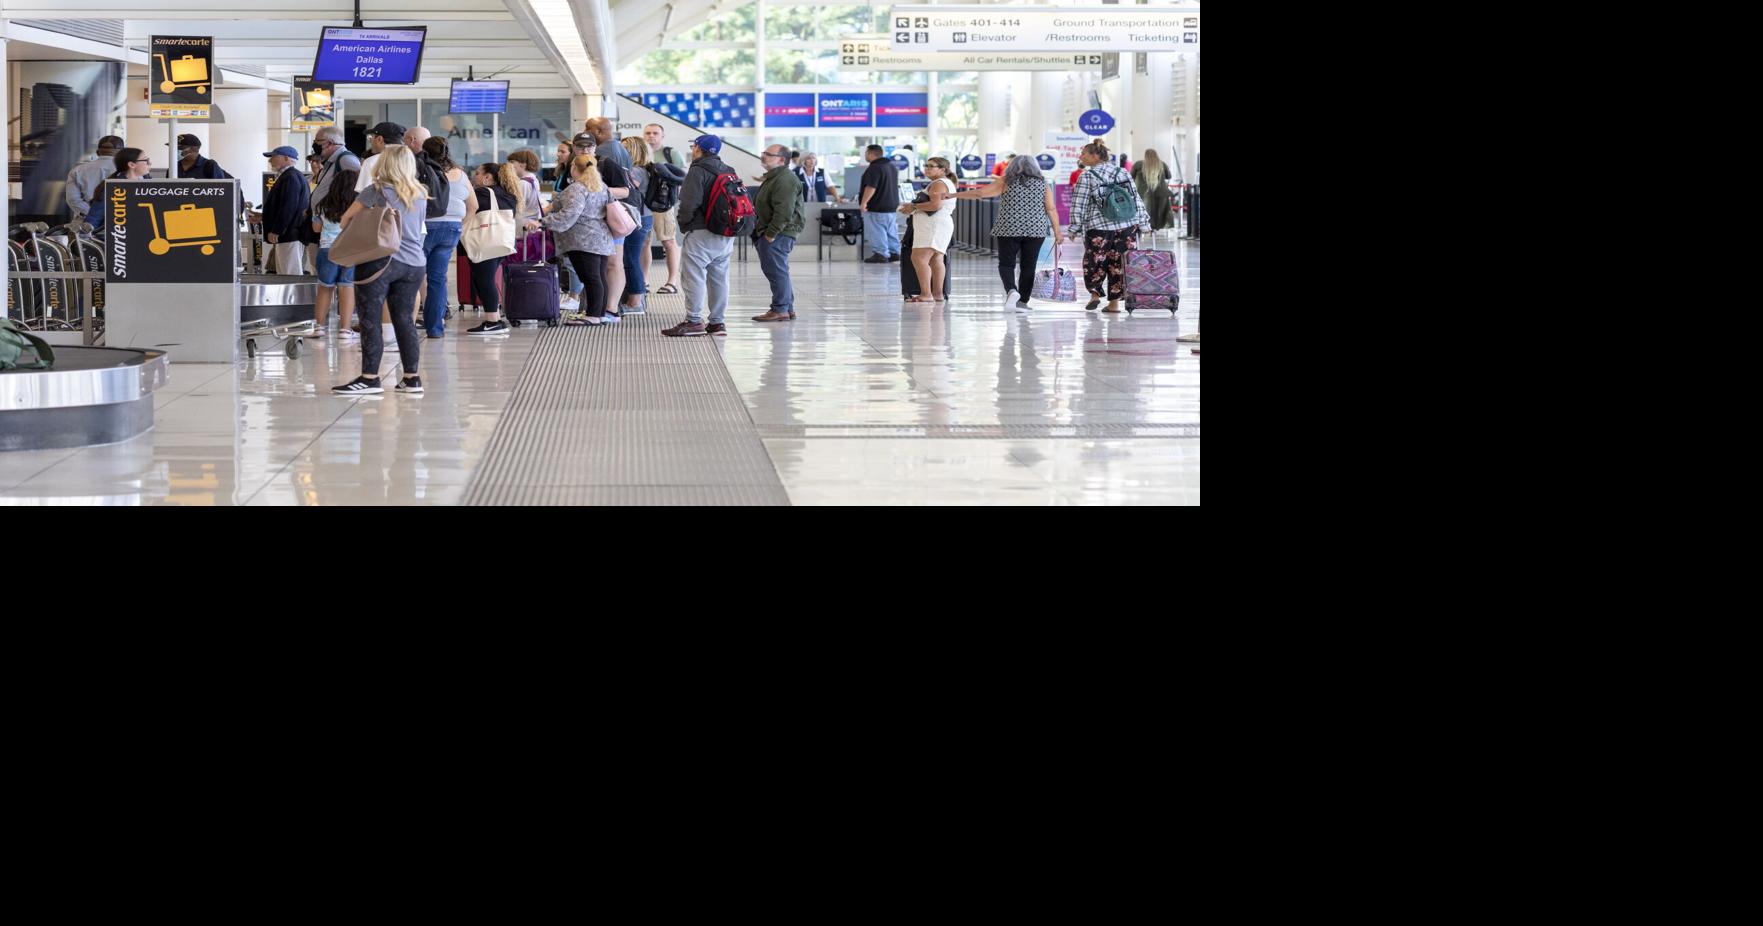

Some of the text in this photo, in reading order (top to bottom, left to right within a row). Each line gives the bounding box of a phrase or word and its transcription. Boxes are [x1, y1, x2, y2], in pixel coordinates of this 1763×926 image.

[933, 19, 967, 27] Gates
[1053, 19, 1180, 28] Ground Transportation
[153, 38, 210, 46] smartecarte
[971, 33, 1017, 42] Elevator
[1128, 33, 1180, 43] Ticketing
[332, 44, 412, 54] American Airlines
[356, 55, 384, 64] Dallas
[352, 66, 383, 78] 1821
[135, 187, 225, 196] LUGGAGE CARTS
[111, 187, 127, 278] smartecarte
[45, 254, 60, 309] smtecarte
